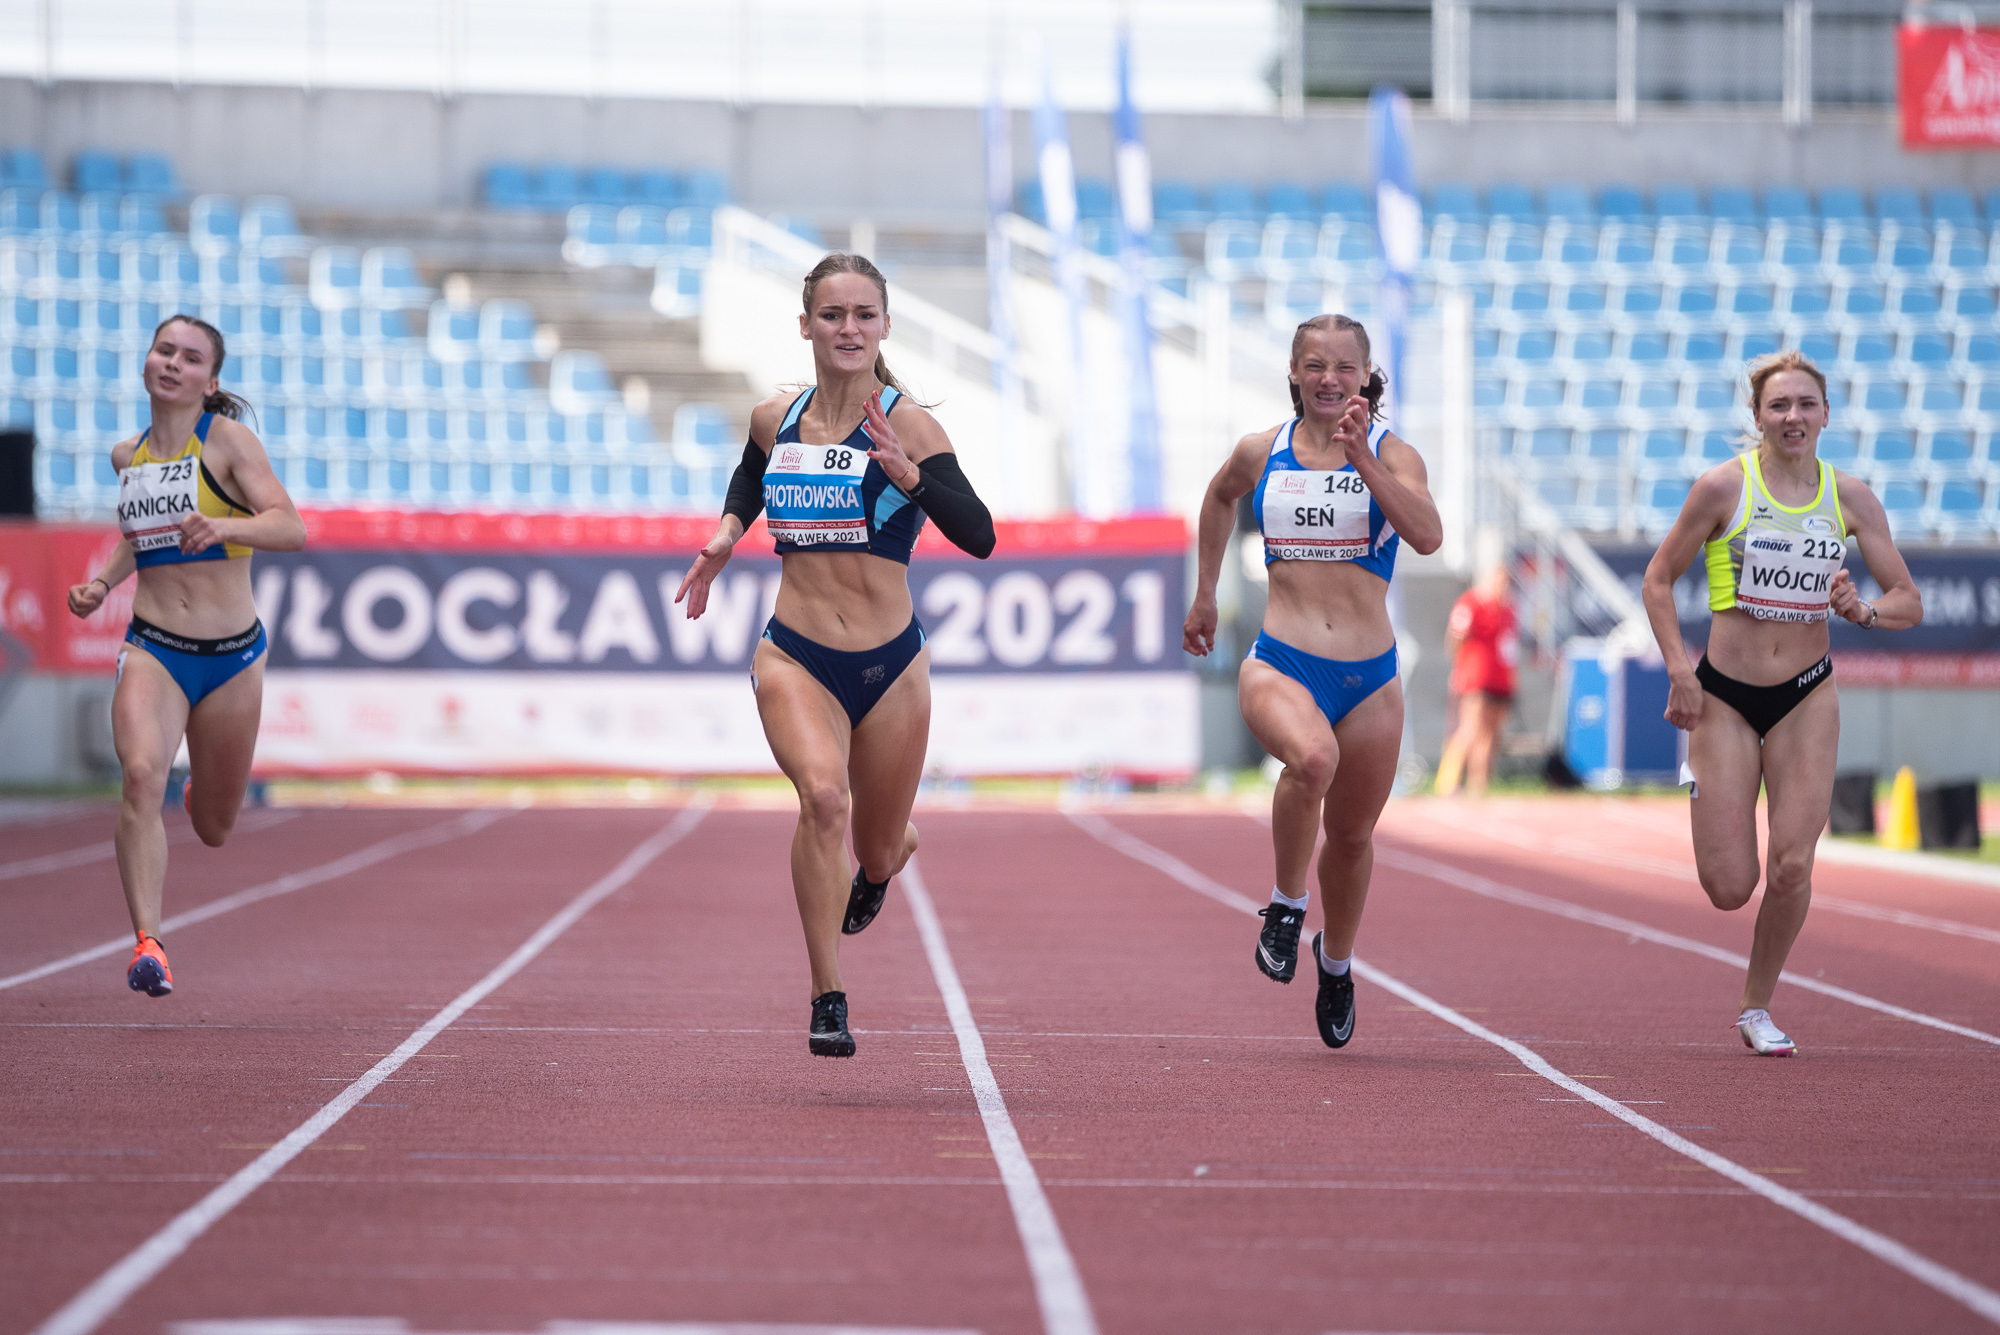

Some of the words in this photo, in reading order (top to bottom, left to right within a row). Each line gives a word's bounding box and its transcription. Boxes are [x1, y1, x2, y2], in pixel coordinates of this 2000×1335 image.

[778, 449, 803, 464] Anwil
[824, 448, 853, 471] 88
[159, 463, 193, 484] 723
[1324, 475, 1365, 494] 148
[764, 484, 860, 509] PIOTROWSKA
[1294, 503, 1335, 527] SEŃ
[833, 531, 860, 542] 2021
[1270, 547, 1337, 559] WŁOCŁAWEK
[1802, 538, 1841, 560] 212
[1752, 565, 1831, 593] WÓJCIK
[922, 569, 1166, 667] 2021
[1741, 604, 1807, 622] WŁOCŁAWEK
[1798, 661, 1825, 688] NIKE
